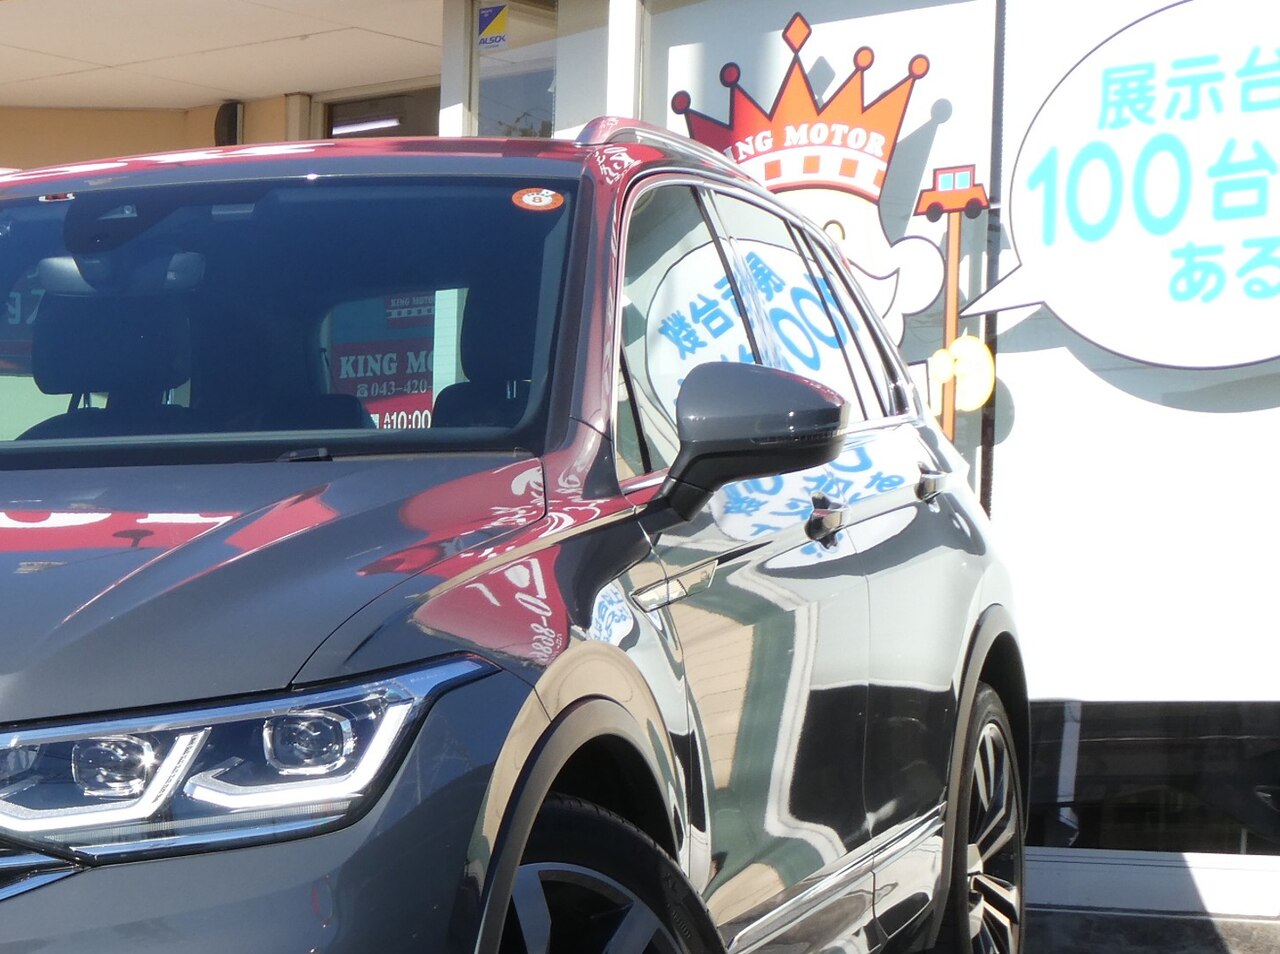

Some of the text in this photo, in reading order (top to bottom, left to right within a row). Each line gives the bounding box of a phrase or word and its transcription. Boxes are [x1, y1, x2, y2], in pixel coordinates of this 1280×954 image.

[723, 122, 886, 164] ING MOTOR
[339, 352, 398, 379] KING
